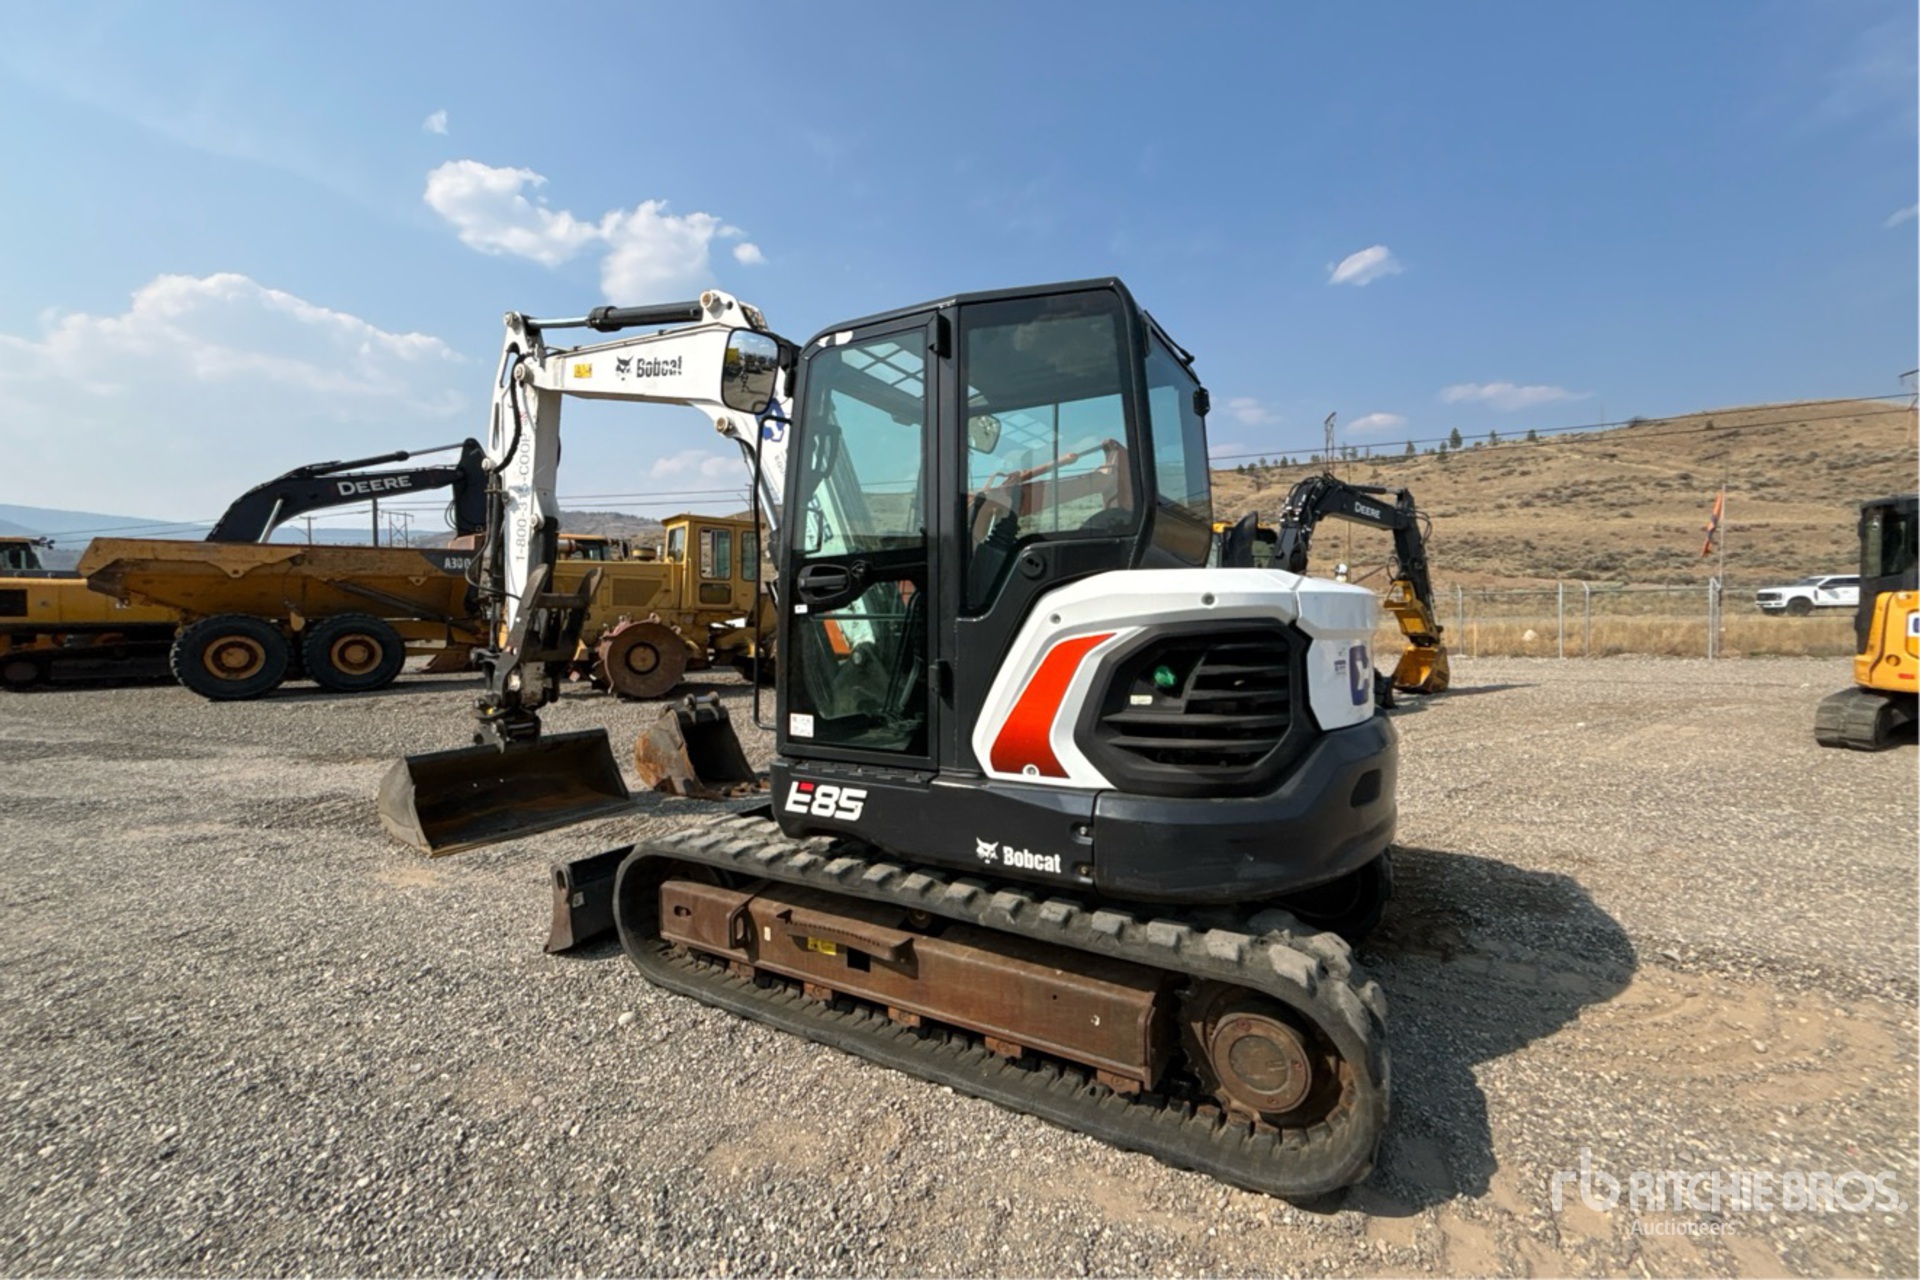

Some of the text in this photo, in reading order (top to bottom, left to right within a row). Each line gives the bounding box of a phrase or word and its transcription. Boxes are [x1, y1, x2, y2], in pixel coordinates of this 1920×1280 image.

[636, 355, 682, 378] Bobcat
[337, 475, 412, 496] DEERE
[785, 781, 867, 821] E85
[1003, 846, 1061, 873] Bobcat
